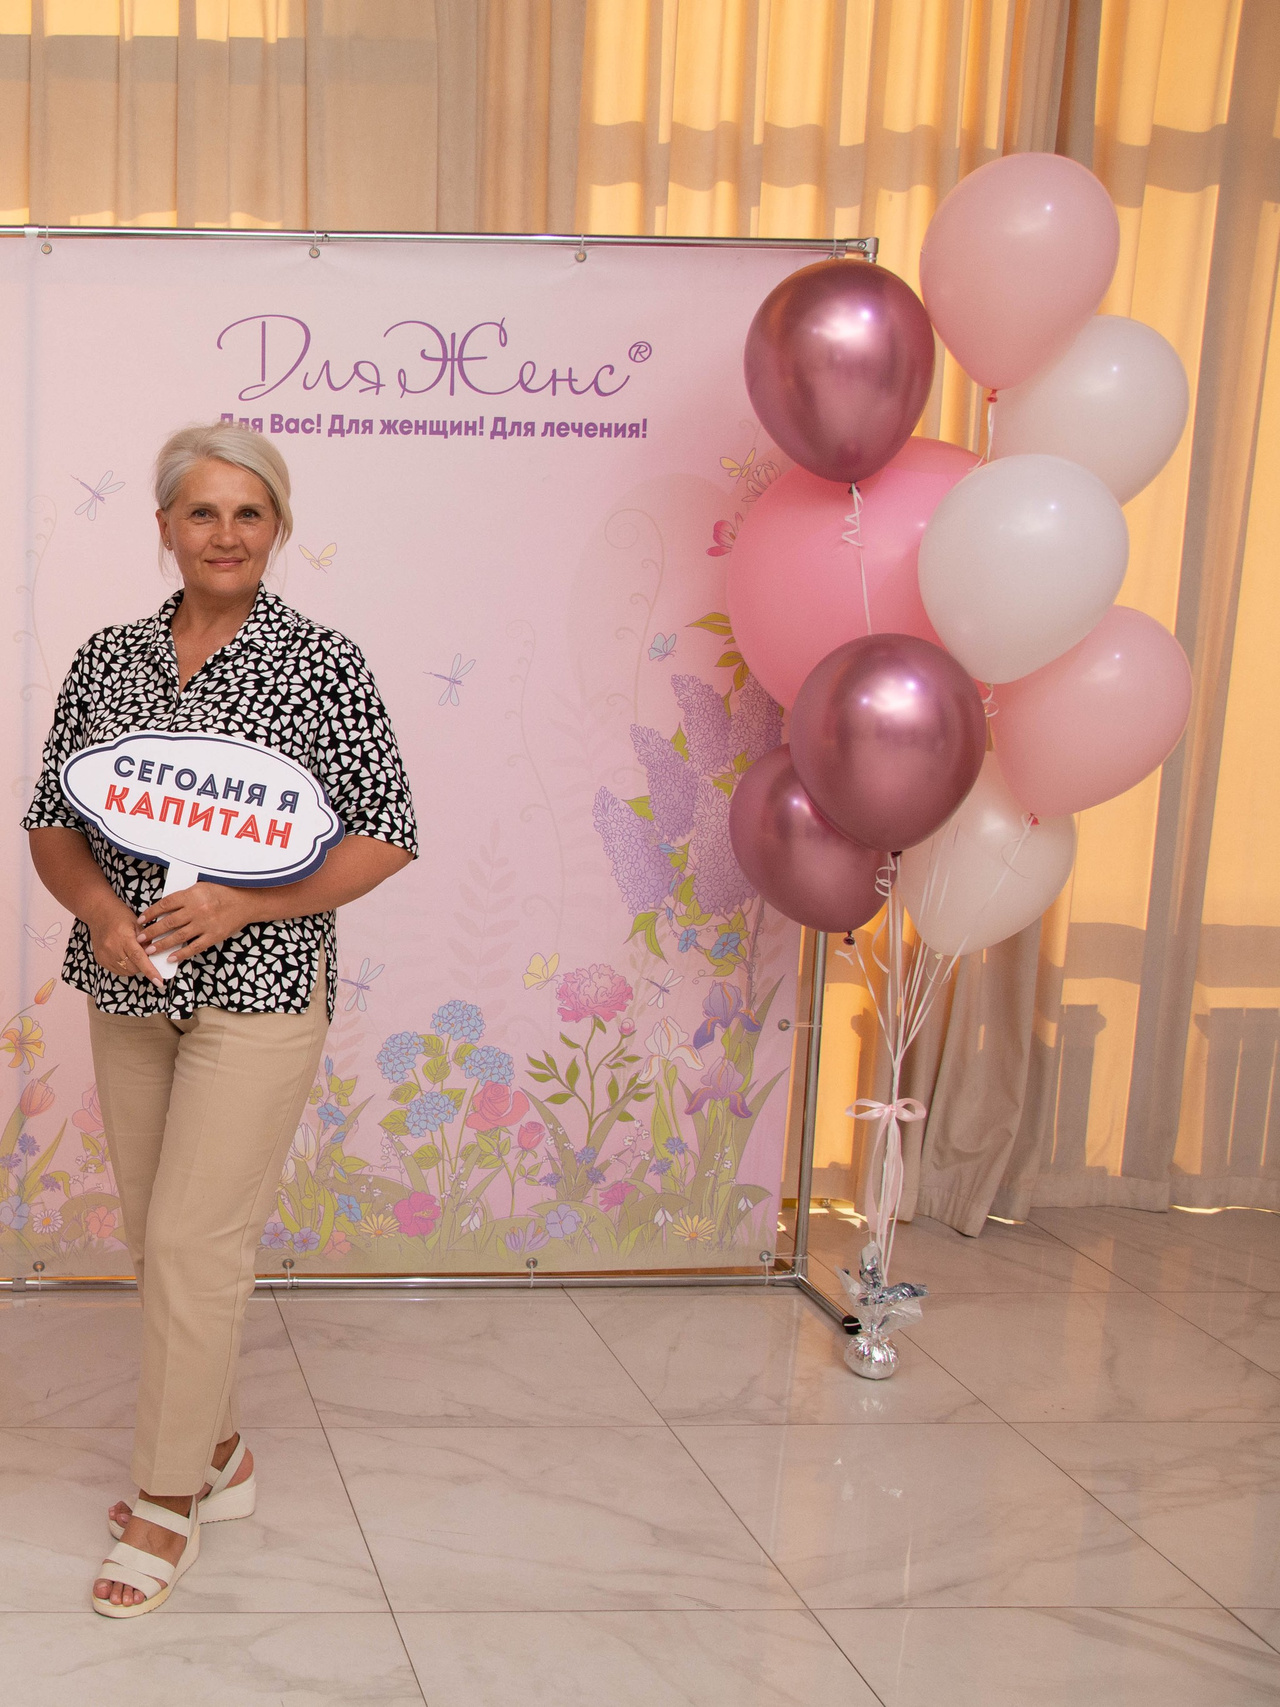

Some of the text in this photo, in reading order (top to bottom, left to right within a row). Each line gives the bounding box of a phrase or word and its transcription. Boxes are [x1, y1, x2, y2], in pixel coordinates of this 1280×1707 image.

[270, 413, 322, 434] Вас!
[327, 414, 373, 438] Для
[379, 416, 485, 439] женщин!
[490, 417, 535, 440] Для
[540, 418, 648, 439] лечения!
[114, 755, 300, 814] СЕГОДНЯ Я
[104, 784, 293, 849] КАПИТАН
